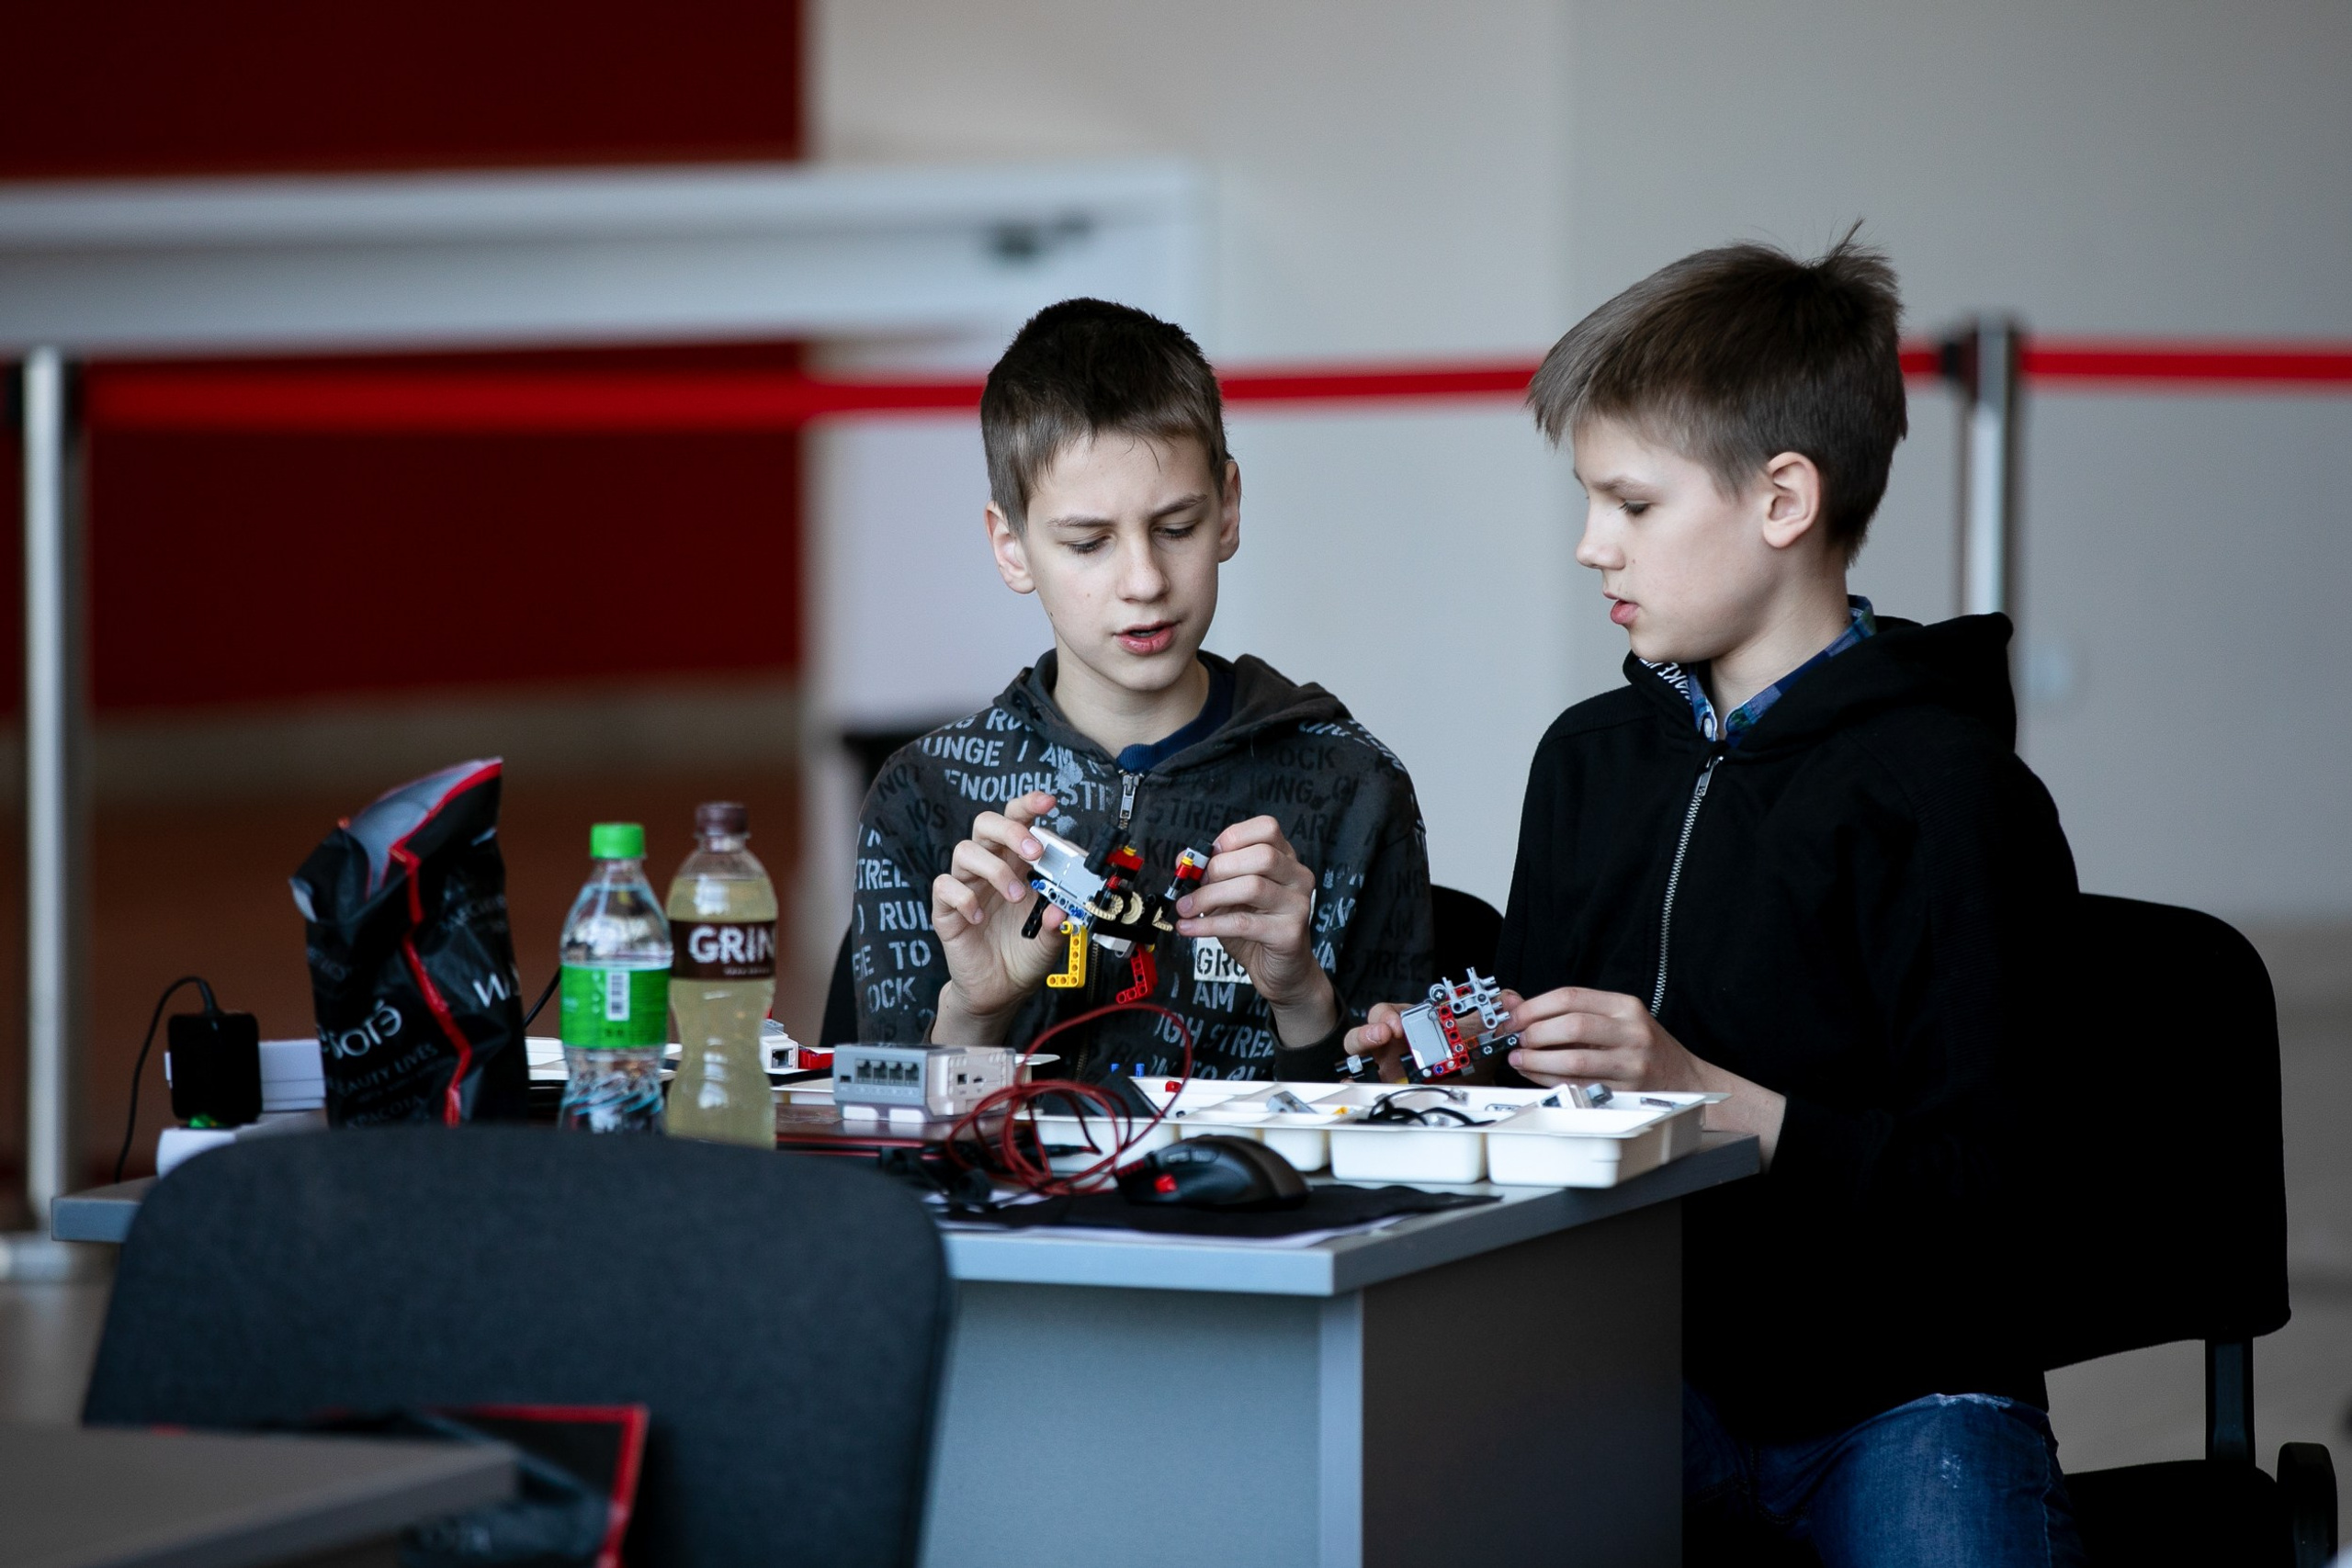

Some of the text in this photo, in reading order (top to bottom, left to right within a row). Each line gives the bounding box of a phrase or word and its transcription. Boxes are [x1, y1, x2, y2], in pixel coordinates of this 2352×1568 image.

[919, 736, 1004, 767] UNGE
[888, 939, 932, 970] TO
[1193, 981, 1237, 1014] AM
